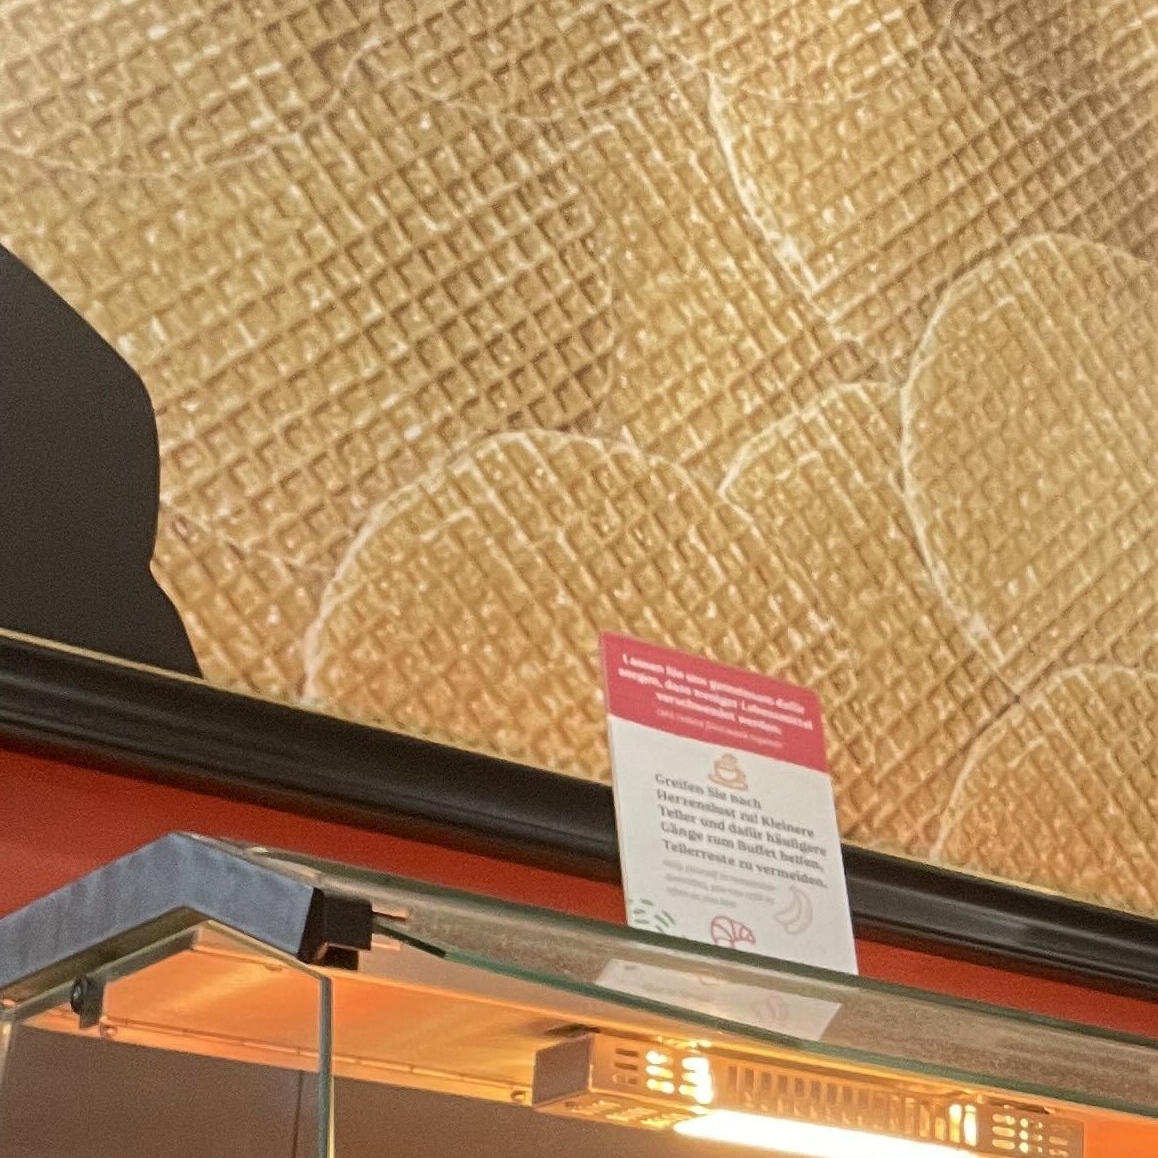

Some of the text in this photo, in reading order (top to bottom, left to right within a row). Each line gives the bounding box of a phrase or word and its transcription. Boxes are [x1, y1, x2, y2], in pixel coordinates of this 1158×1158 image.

[655, 773, 761, 809] Greifen Sie nach
[658, 804, 696, 824] Teller
[700, 817, 725, 832] und
[762, 815, 814, 837] Kleinere
[660, 821, 704, 842] Gänge
[738, 840, 777, 859] Buffet
[739, 860, 753, 871] zu
